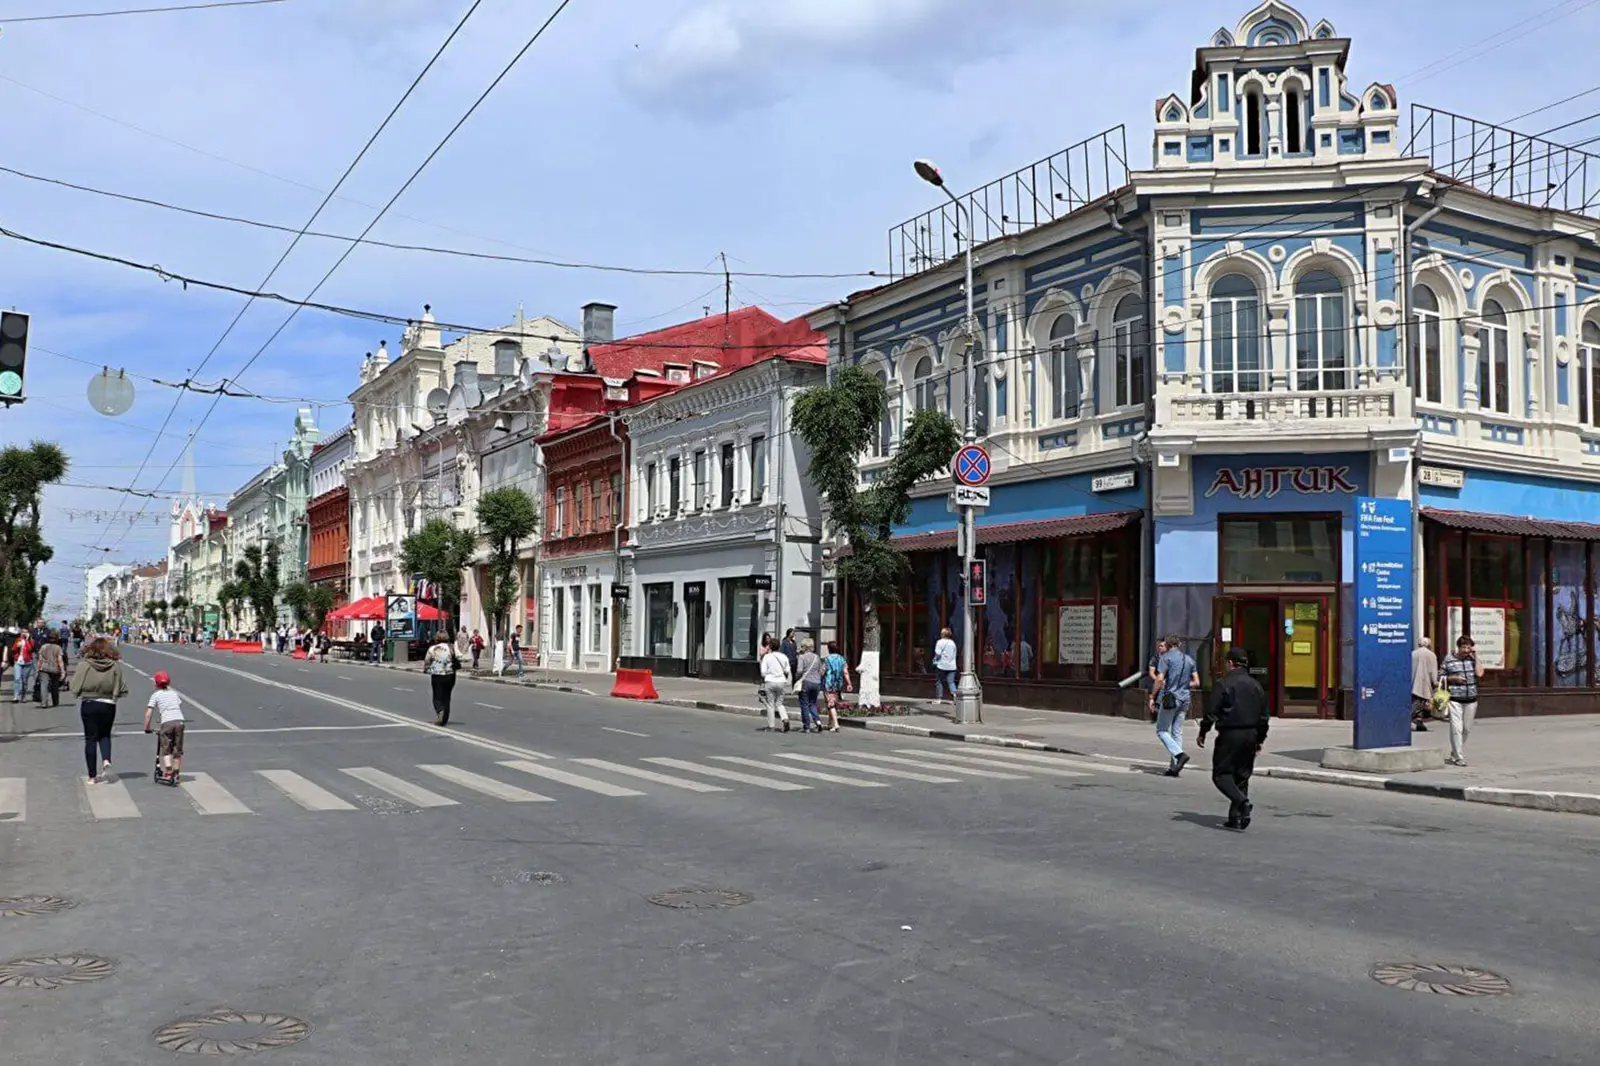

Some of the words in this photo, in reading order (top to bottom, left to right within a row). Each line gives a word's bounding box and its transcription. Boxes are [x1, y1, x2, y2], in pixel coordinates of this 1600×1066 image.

[1095, 479, 1102, 489] 99
[1204, 466, 1359, 499] АНТИК
[1360, 514, 1372, 522] FIFA
[1373, 514, 1382, 523] Fan
[1383, 515, 1394, 524] Fest
